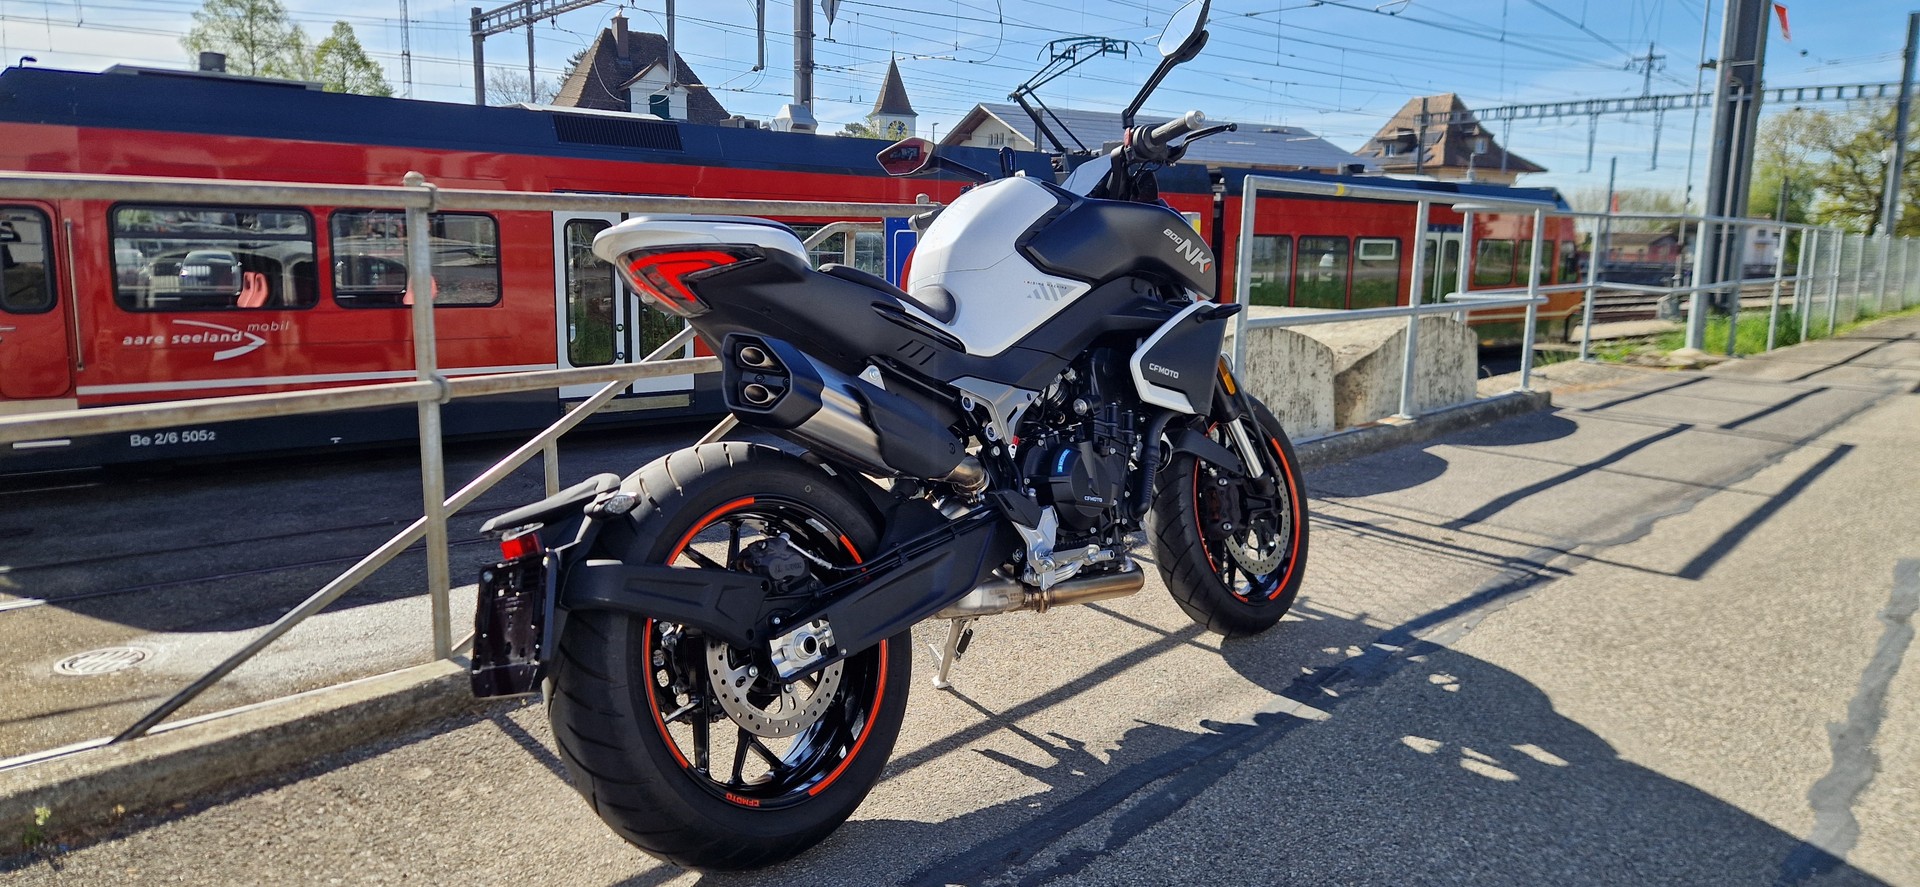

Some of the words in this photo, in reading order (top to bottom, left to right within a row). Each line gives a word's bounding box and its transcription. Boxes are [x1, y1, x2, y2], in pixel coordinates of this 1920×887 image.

[247, 321, 289, 332] mobil
[122, 334, 165, 346] aare
[171, 331, 244, 344] seeland
[1148, 362, 1180, 379] CFMOTO
[130, 434, 151, 447] Be
[154, 432, 179, 445] 2/6
[725, 792, 760, 807] CFMOTO
